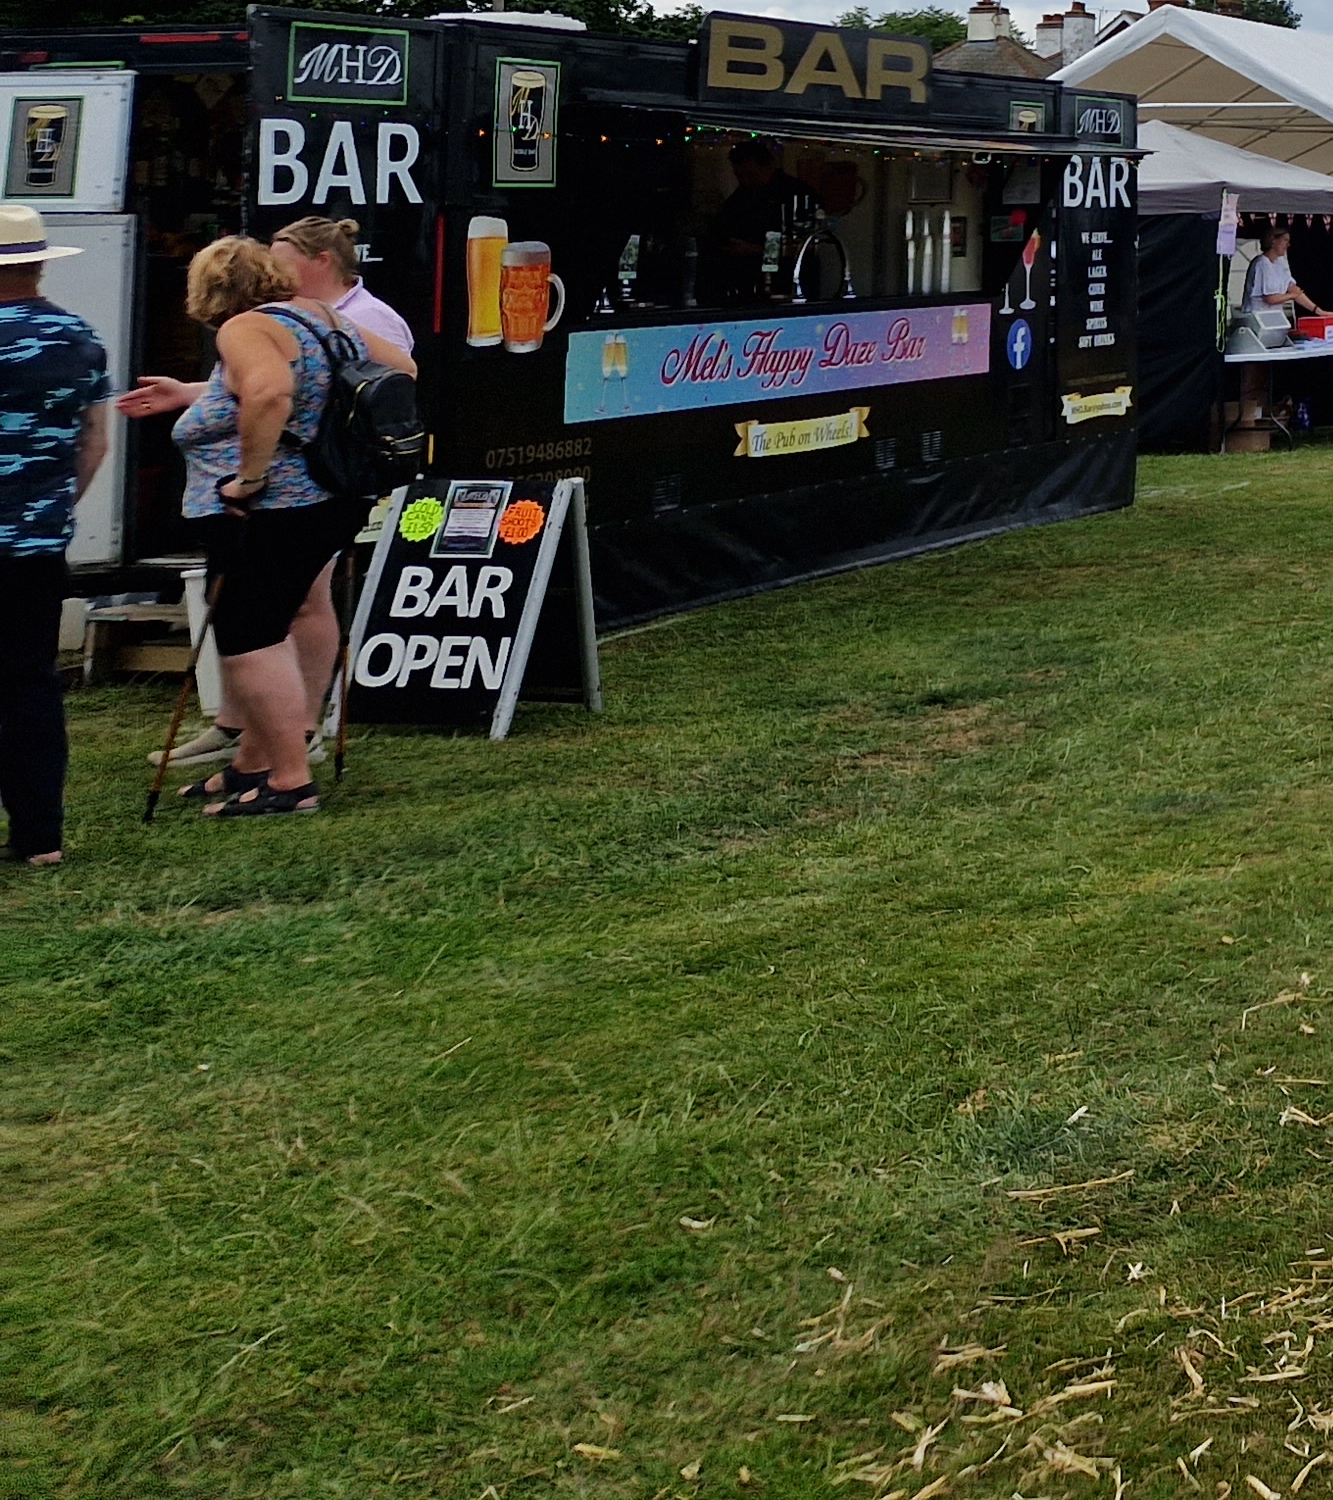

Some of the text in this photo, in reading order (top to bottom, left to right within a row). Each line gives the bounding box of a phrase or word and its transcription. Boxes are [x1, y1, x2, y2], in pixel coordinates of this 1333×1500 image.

[294, 42, 404, 85] MHD
[707, 18, 928, 104] BAR
[1077, 108, 1122, 134] MHD
[257, 118, 425, 206] BAR
[1063, 154, 1132, 208] BAR
[661, 317, 927, 389] Mel's Happy Daze Bar
[485, 437, 592, 469] 07519486882
[751, 419, 853, 452] The Pub on Wheels!
[413, 501, 440, 515] COLD
[509, 506, 540, 518] FRUIT
[389, 565, 514, 618] BAR
[354, 633, 512, 690] OPEN
